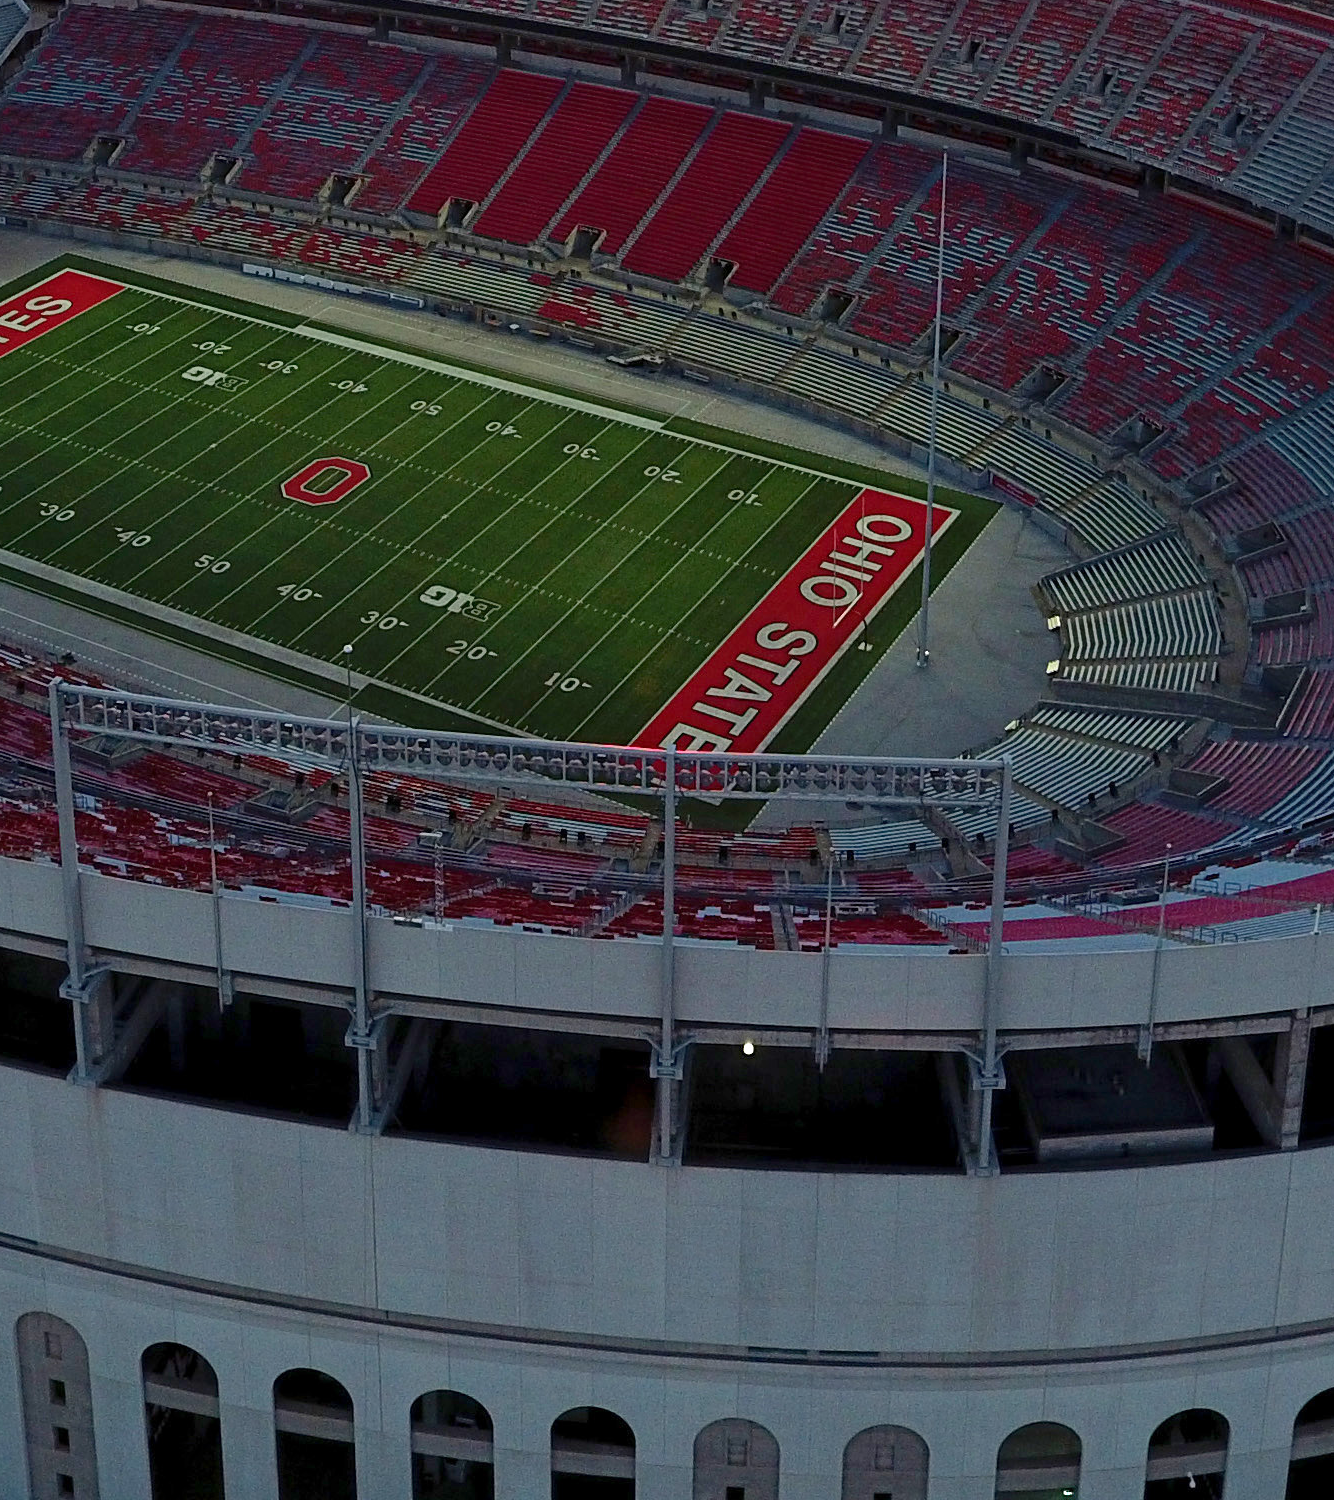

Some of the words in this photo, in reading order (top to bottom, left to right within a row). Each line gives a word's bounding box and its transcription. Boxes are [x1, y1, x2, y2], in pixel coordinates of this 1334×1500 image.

[133, 322, 162, 336] 10
[198, 341, 233, 355] 20
[266, 360, 299, 375] 30
[337, 380, 369, 394] 40
[409, 400, 444, 416] 50
[485, 421, 518, 436] 40
[562, 443, 598, 460] 30
[643, 465, 681, 483] 20
[727, 489, 760, 506] 10
[39, 503, 76, 522] 30
[116, 529, 152, 548] 40
[194, 553, 232, 574] 50
[798, 513, 914, 608] OHIO
[276, 583, 313, 602] 40
[359, 610, 399, 631] 30
[445, 639, 488, 661] 20
[543, 671, 581, 693] 10
[659, 621, 818, 756] STATE
